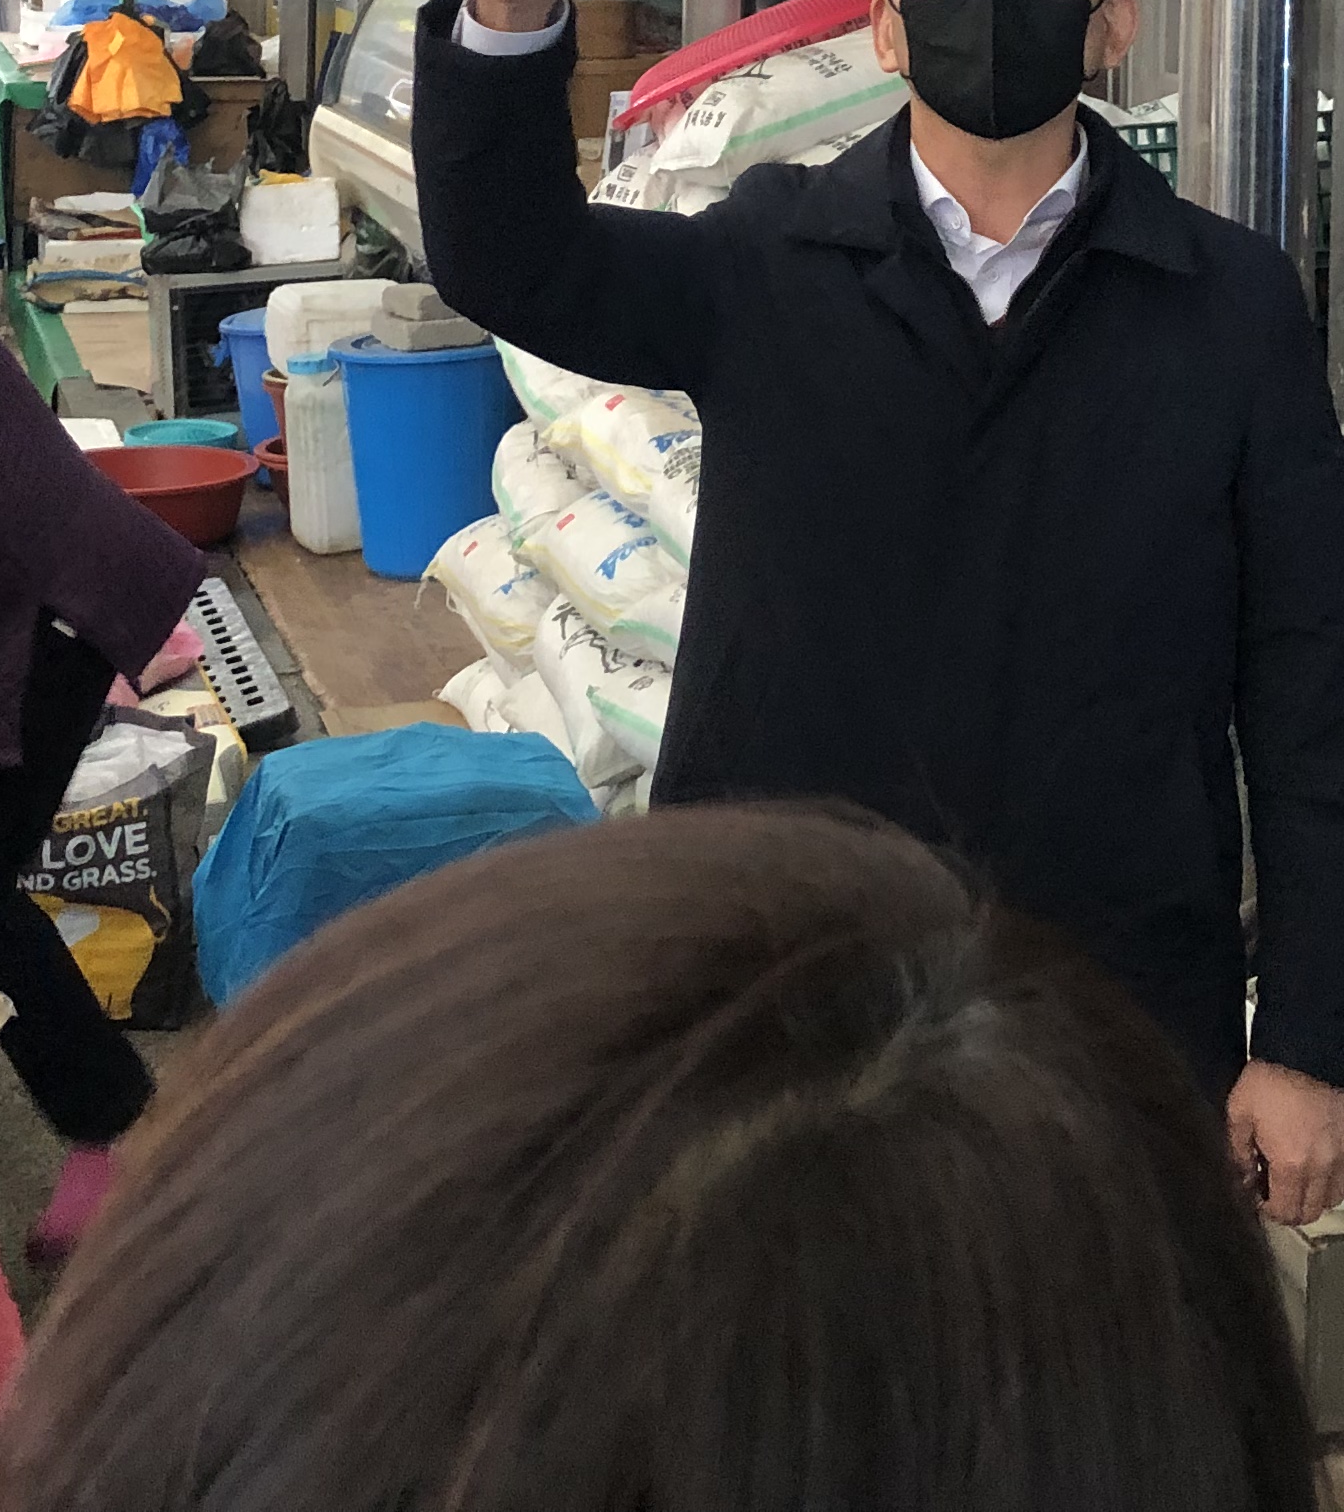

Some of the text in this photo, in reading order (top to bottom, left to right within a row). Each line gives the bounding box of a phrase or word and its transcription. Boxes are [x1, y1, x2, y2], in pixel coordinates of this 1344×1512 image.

[52, 796, 149, 834] GREAT.
[40, 821, 150, 870] LOVE
[62, 856, 158, 892] GRASS.
